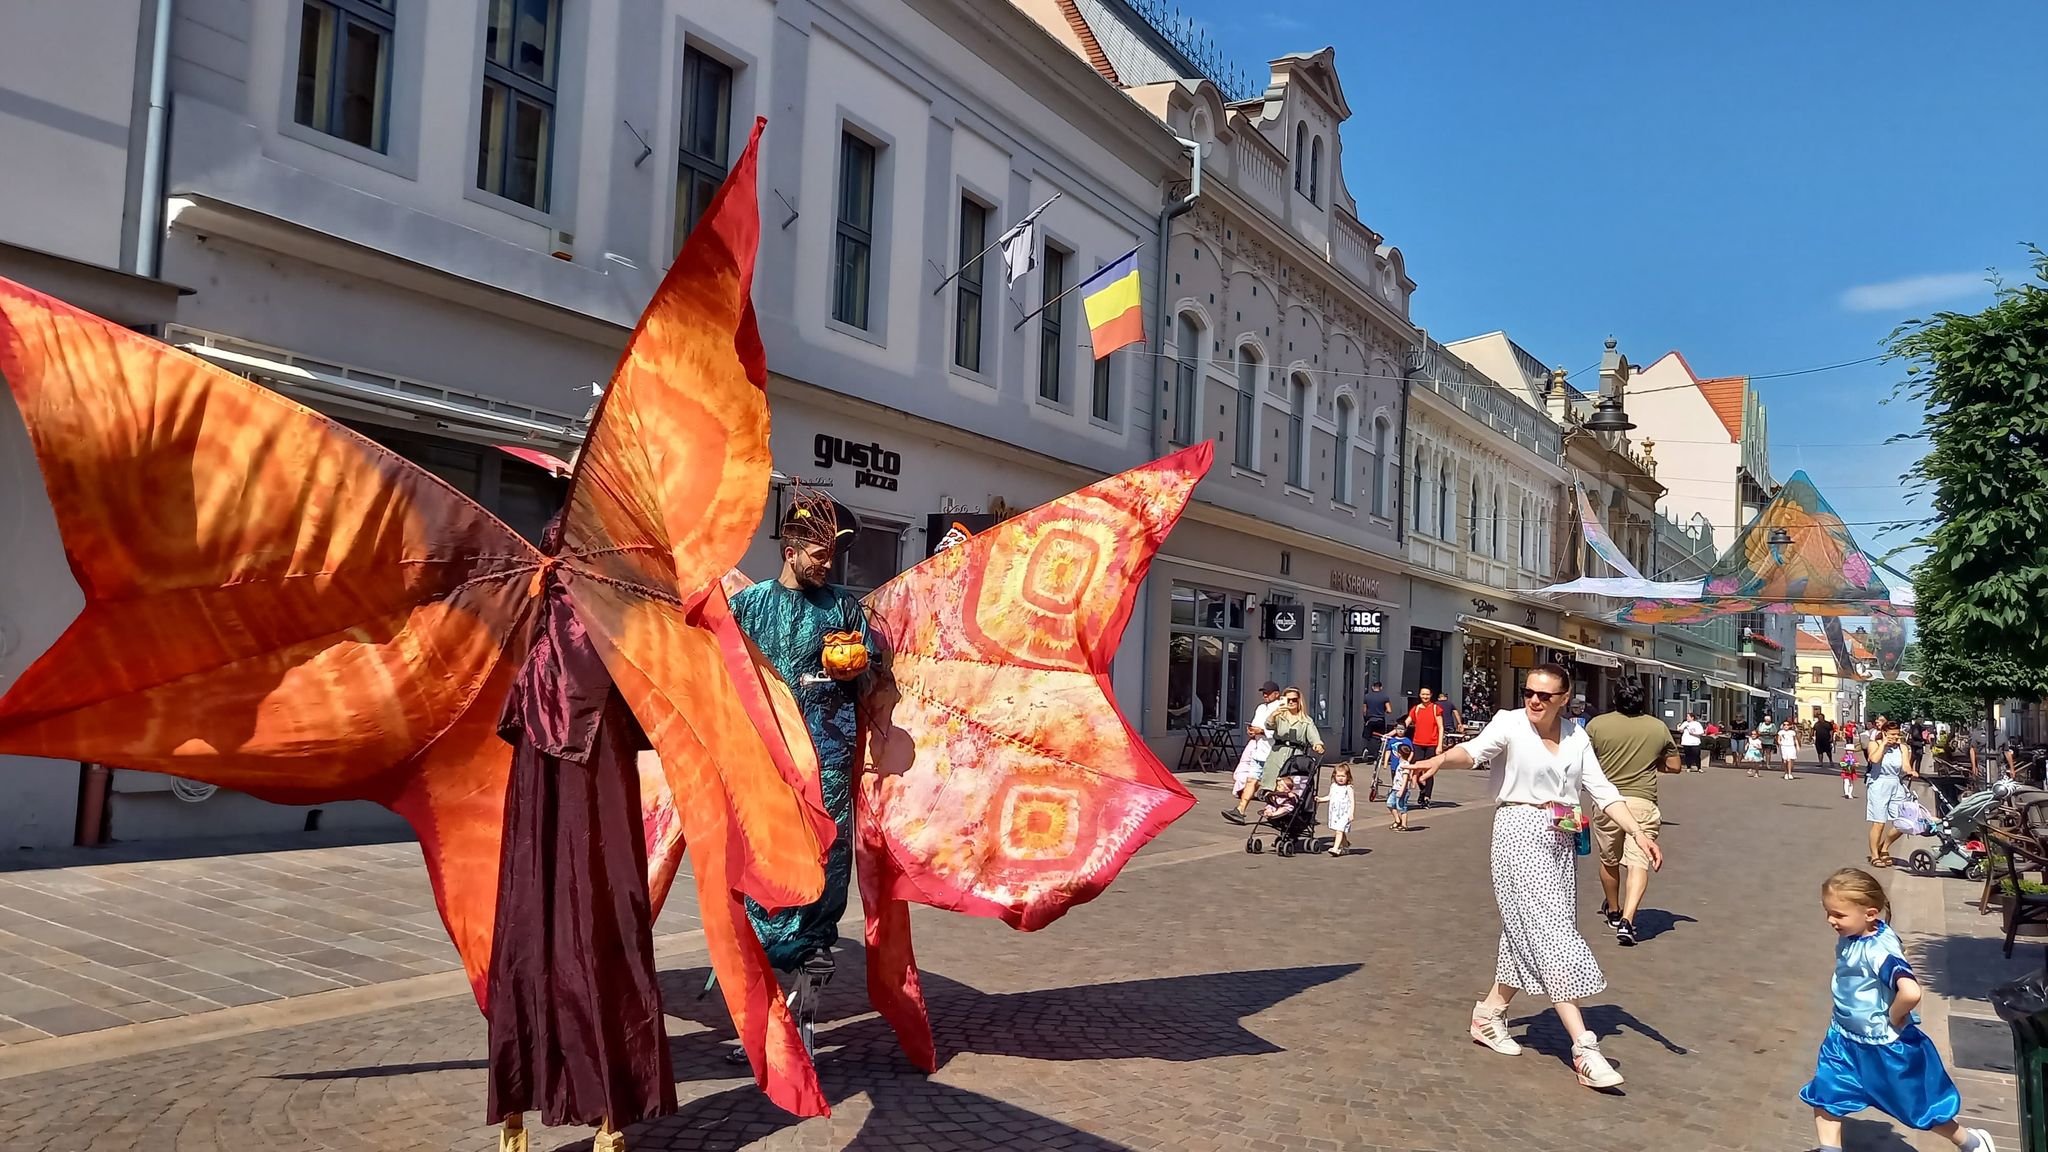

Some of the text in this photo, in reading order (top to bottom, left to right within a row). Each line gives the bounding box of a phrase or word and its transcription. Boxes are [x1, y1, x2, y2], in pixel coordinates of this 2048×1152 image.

[814, 433, 901, 476] gusto
[855, 469, 898, 492] pizza
[1350, 612, 1381, 627] ABC
[1350, 626, 1381, 635] SABOMAG
